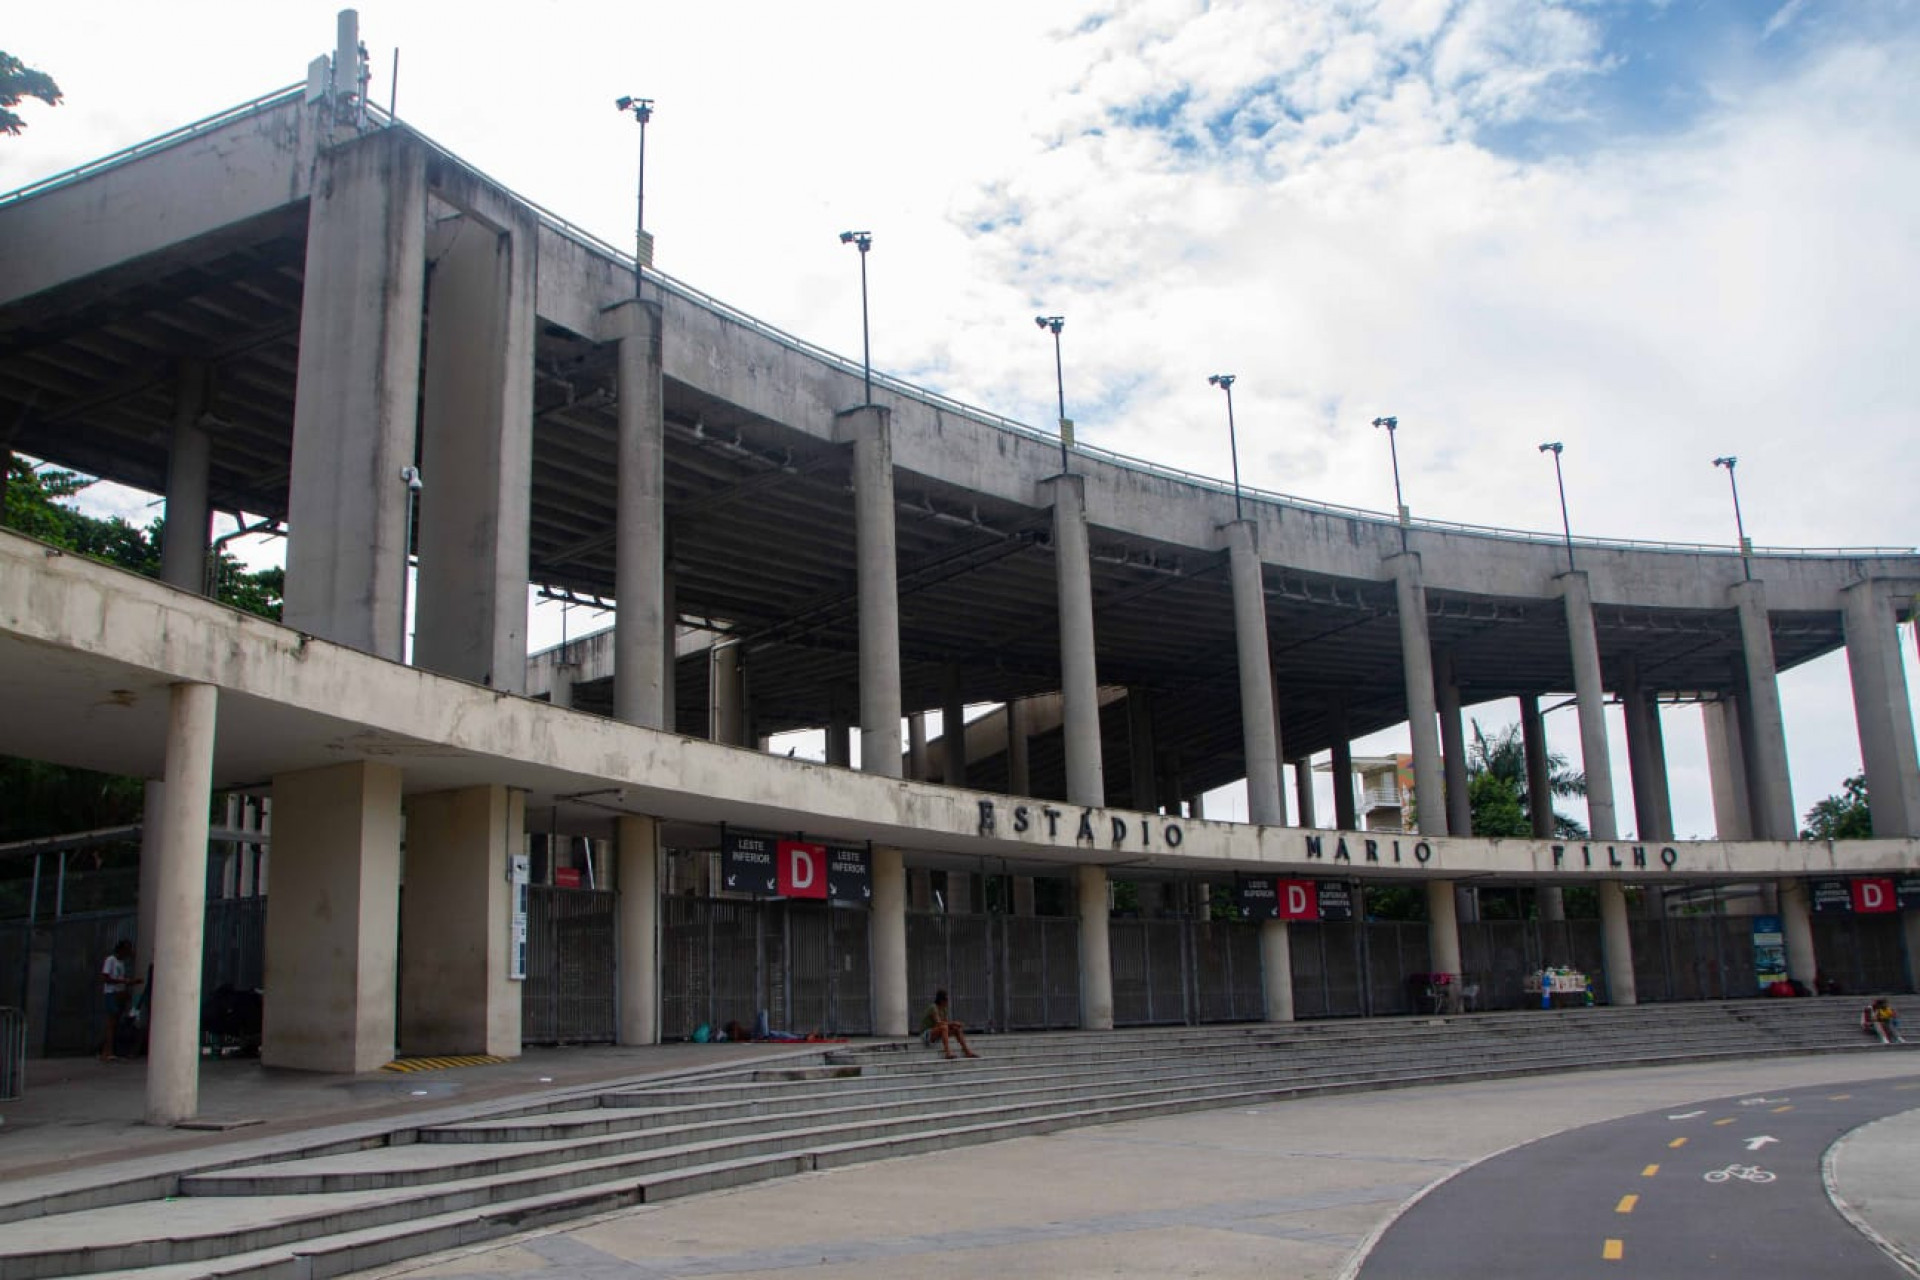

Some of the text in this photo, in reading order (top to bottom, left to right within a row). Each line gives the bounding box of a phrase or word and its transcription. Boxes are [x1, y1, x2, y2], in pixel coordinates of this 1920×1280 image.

[978, 799, 1183, 847] ESTÁDIO
[1552, 845, 1677, 866] FILHO
[738, 839, 764, 851] LESTE
[732, 852, 770, 864] INFERIOR
[838, 851, 860, 862] LESTE
[791, 850, 814, 889] D
[832, 862, 865, 874] INFERIOR
[1288, 885, 1307, 914] D
[1862, 884, 1884, 908] D
